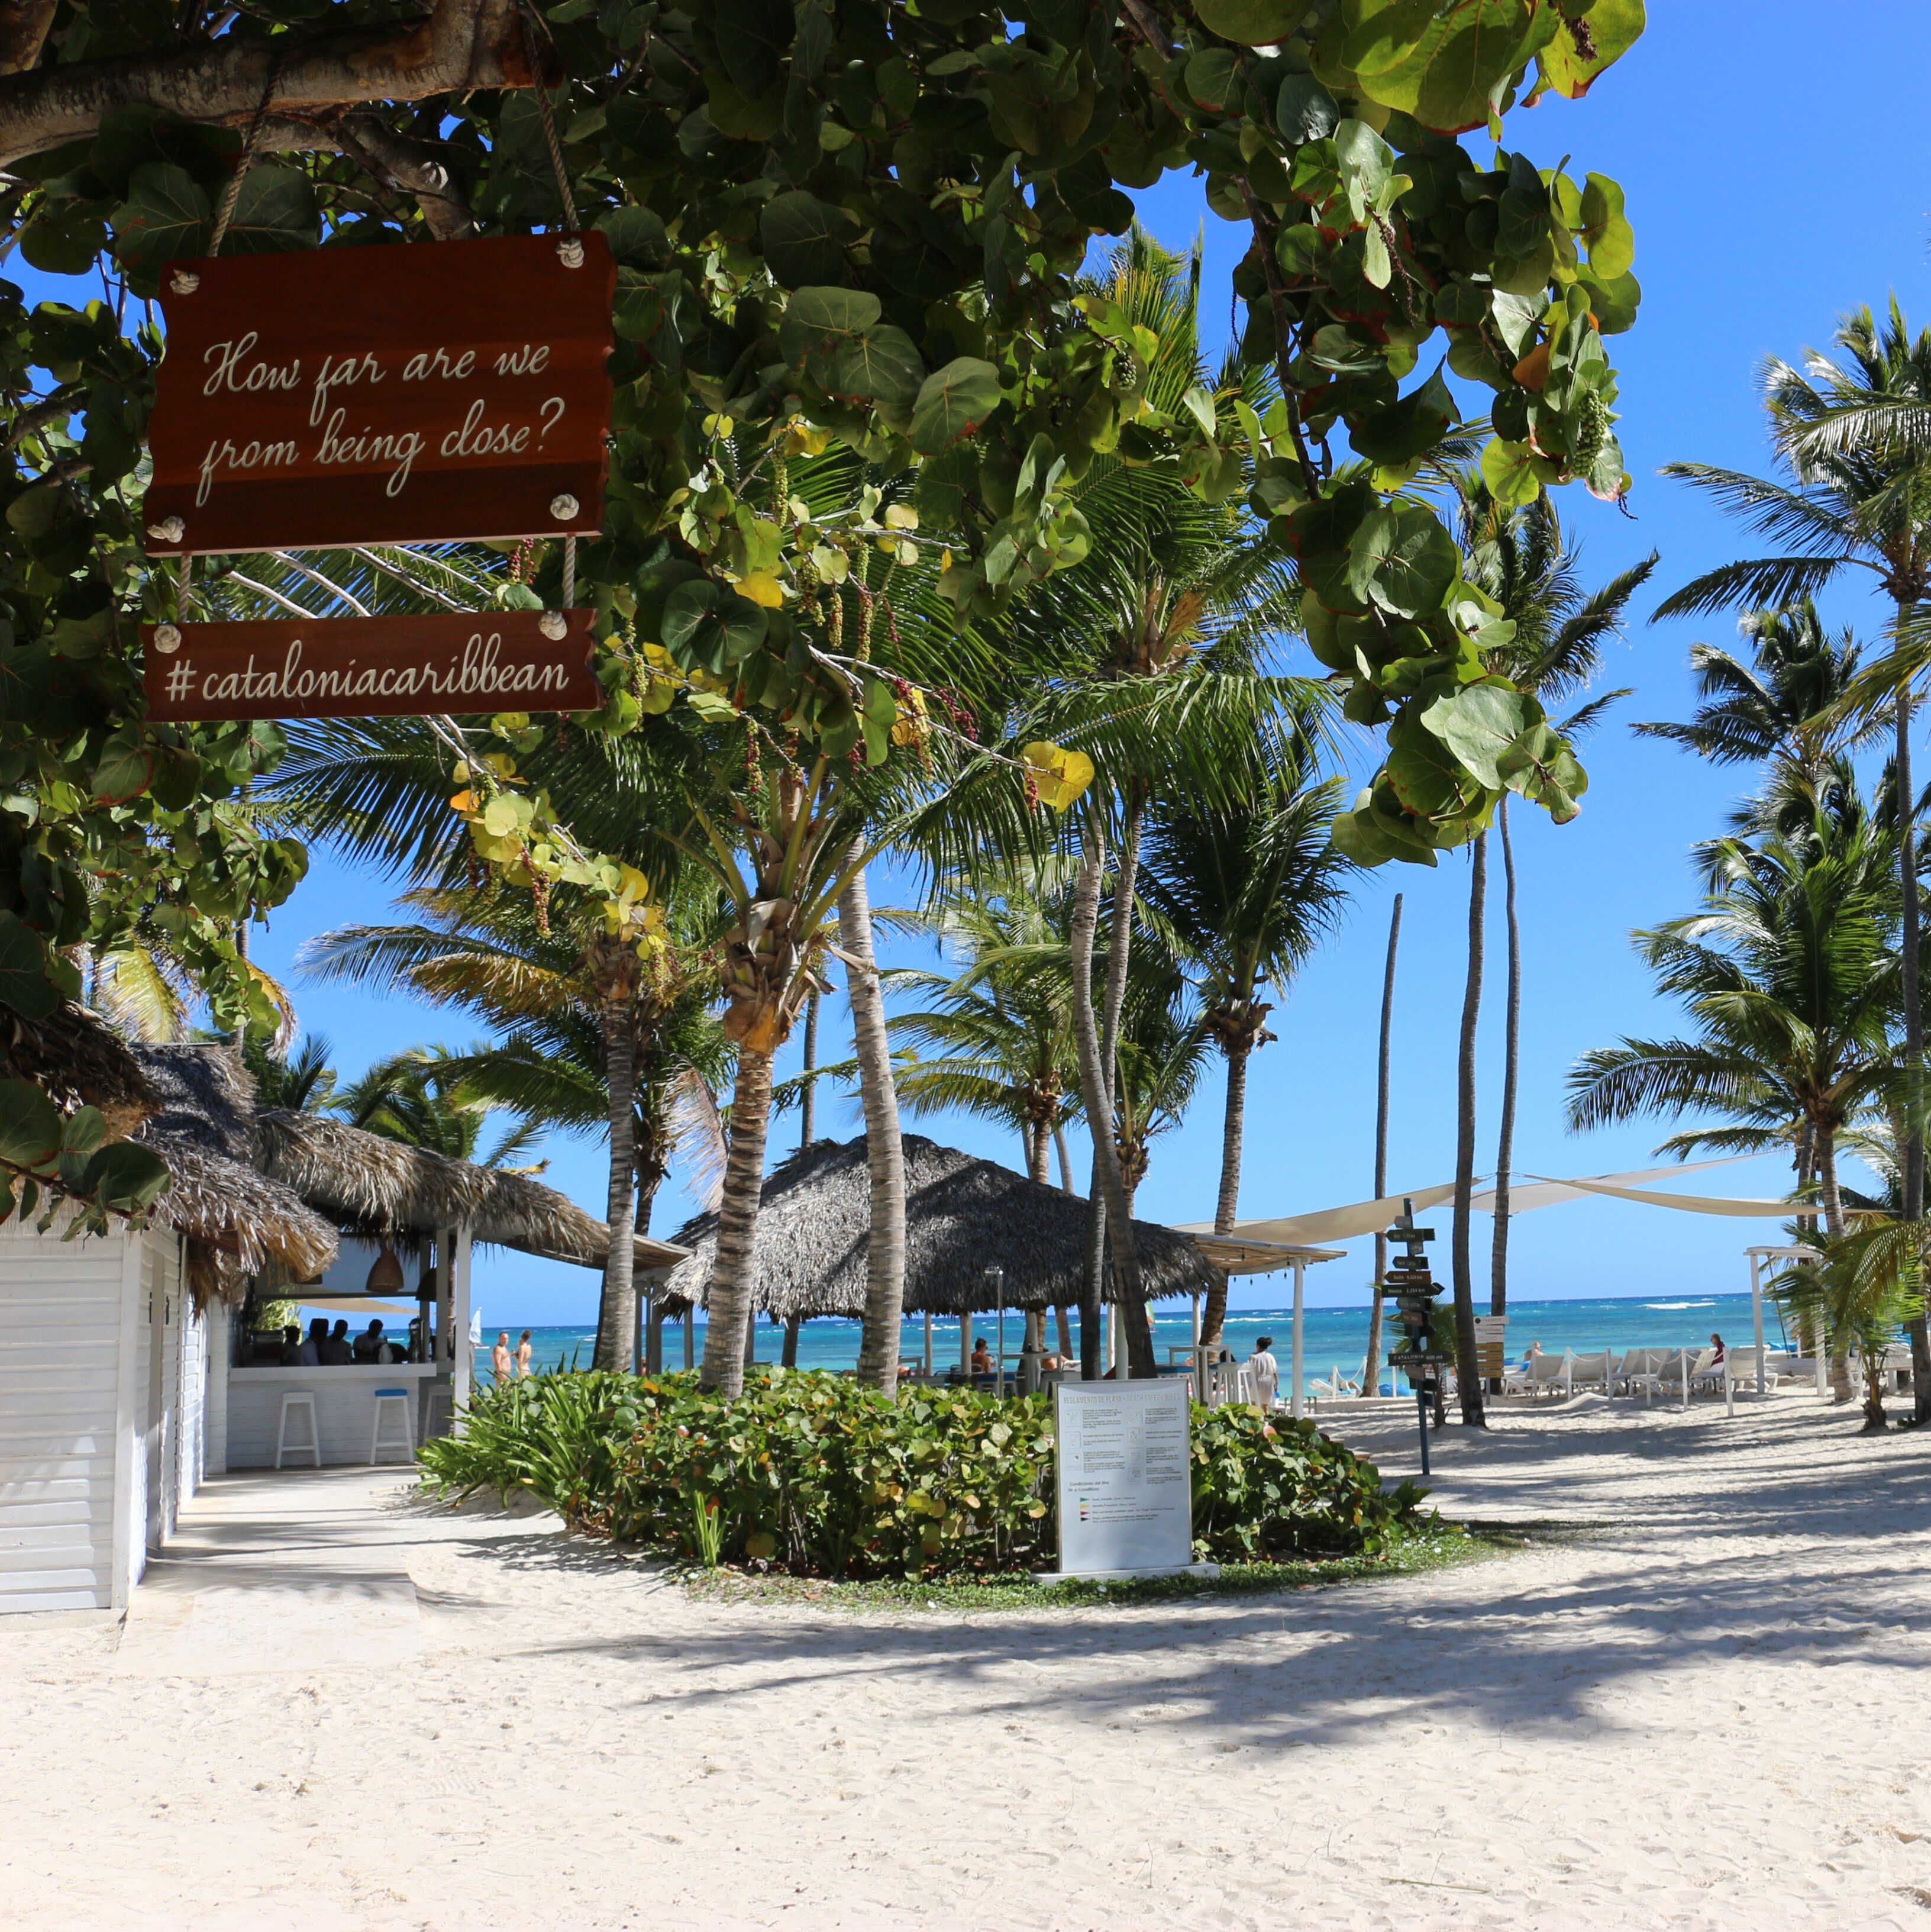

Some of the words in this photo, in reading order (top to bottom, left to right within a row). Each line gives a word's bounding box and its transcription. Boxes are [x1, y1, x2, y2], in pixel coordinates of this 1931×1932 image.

[203, 331, 301, 396] How
[309, 351, 386, 427] far
[402, 347, 476, 382] are
[493, 344, 550, 375] we
[196, 439, 300, 508] from
[314, 407, 425, 498] being
[440, 397, 565, 458] close?
[165, 633, 569, 702] #cataloniacaribbean
